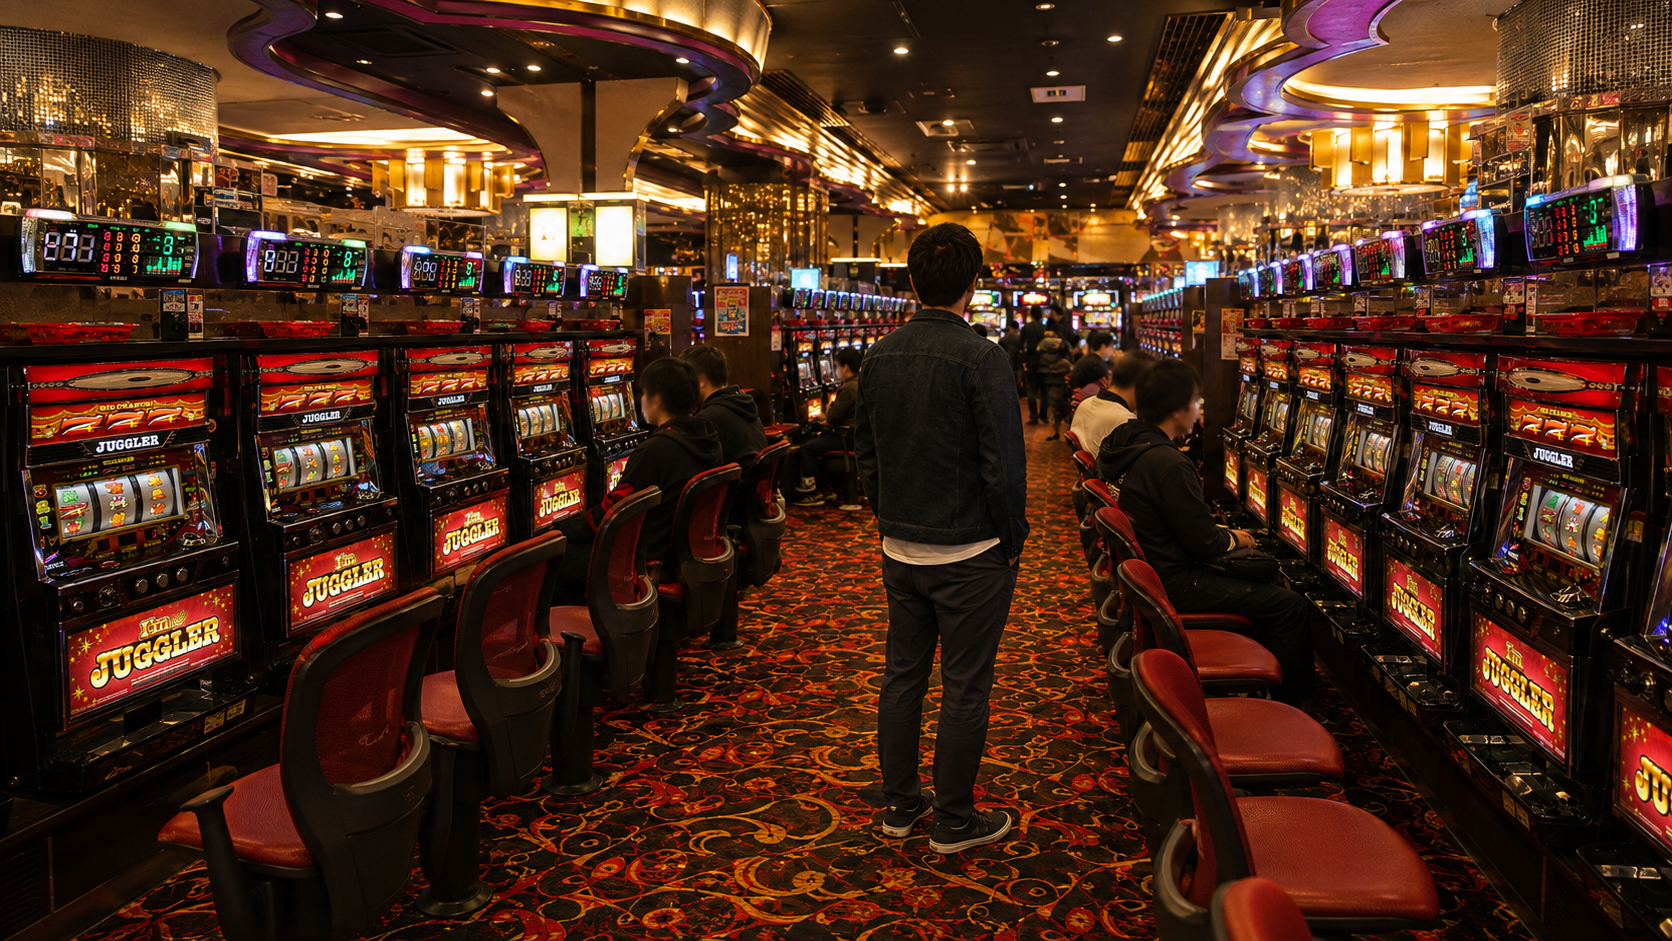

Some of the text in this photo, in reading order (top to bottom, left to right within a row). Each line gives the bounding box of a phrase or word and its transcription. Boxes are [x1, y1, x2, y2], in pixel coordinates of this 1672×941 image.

[95, 434, 160, 454] JUGGLER
[442, 516, 500, 556] JUGGLER
[302, 556, 386, 608] JUGGLER
[90, 615, 221, 690] JUGGLER
[1482, 645, 1556, 734] JUGGLER
